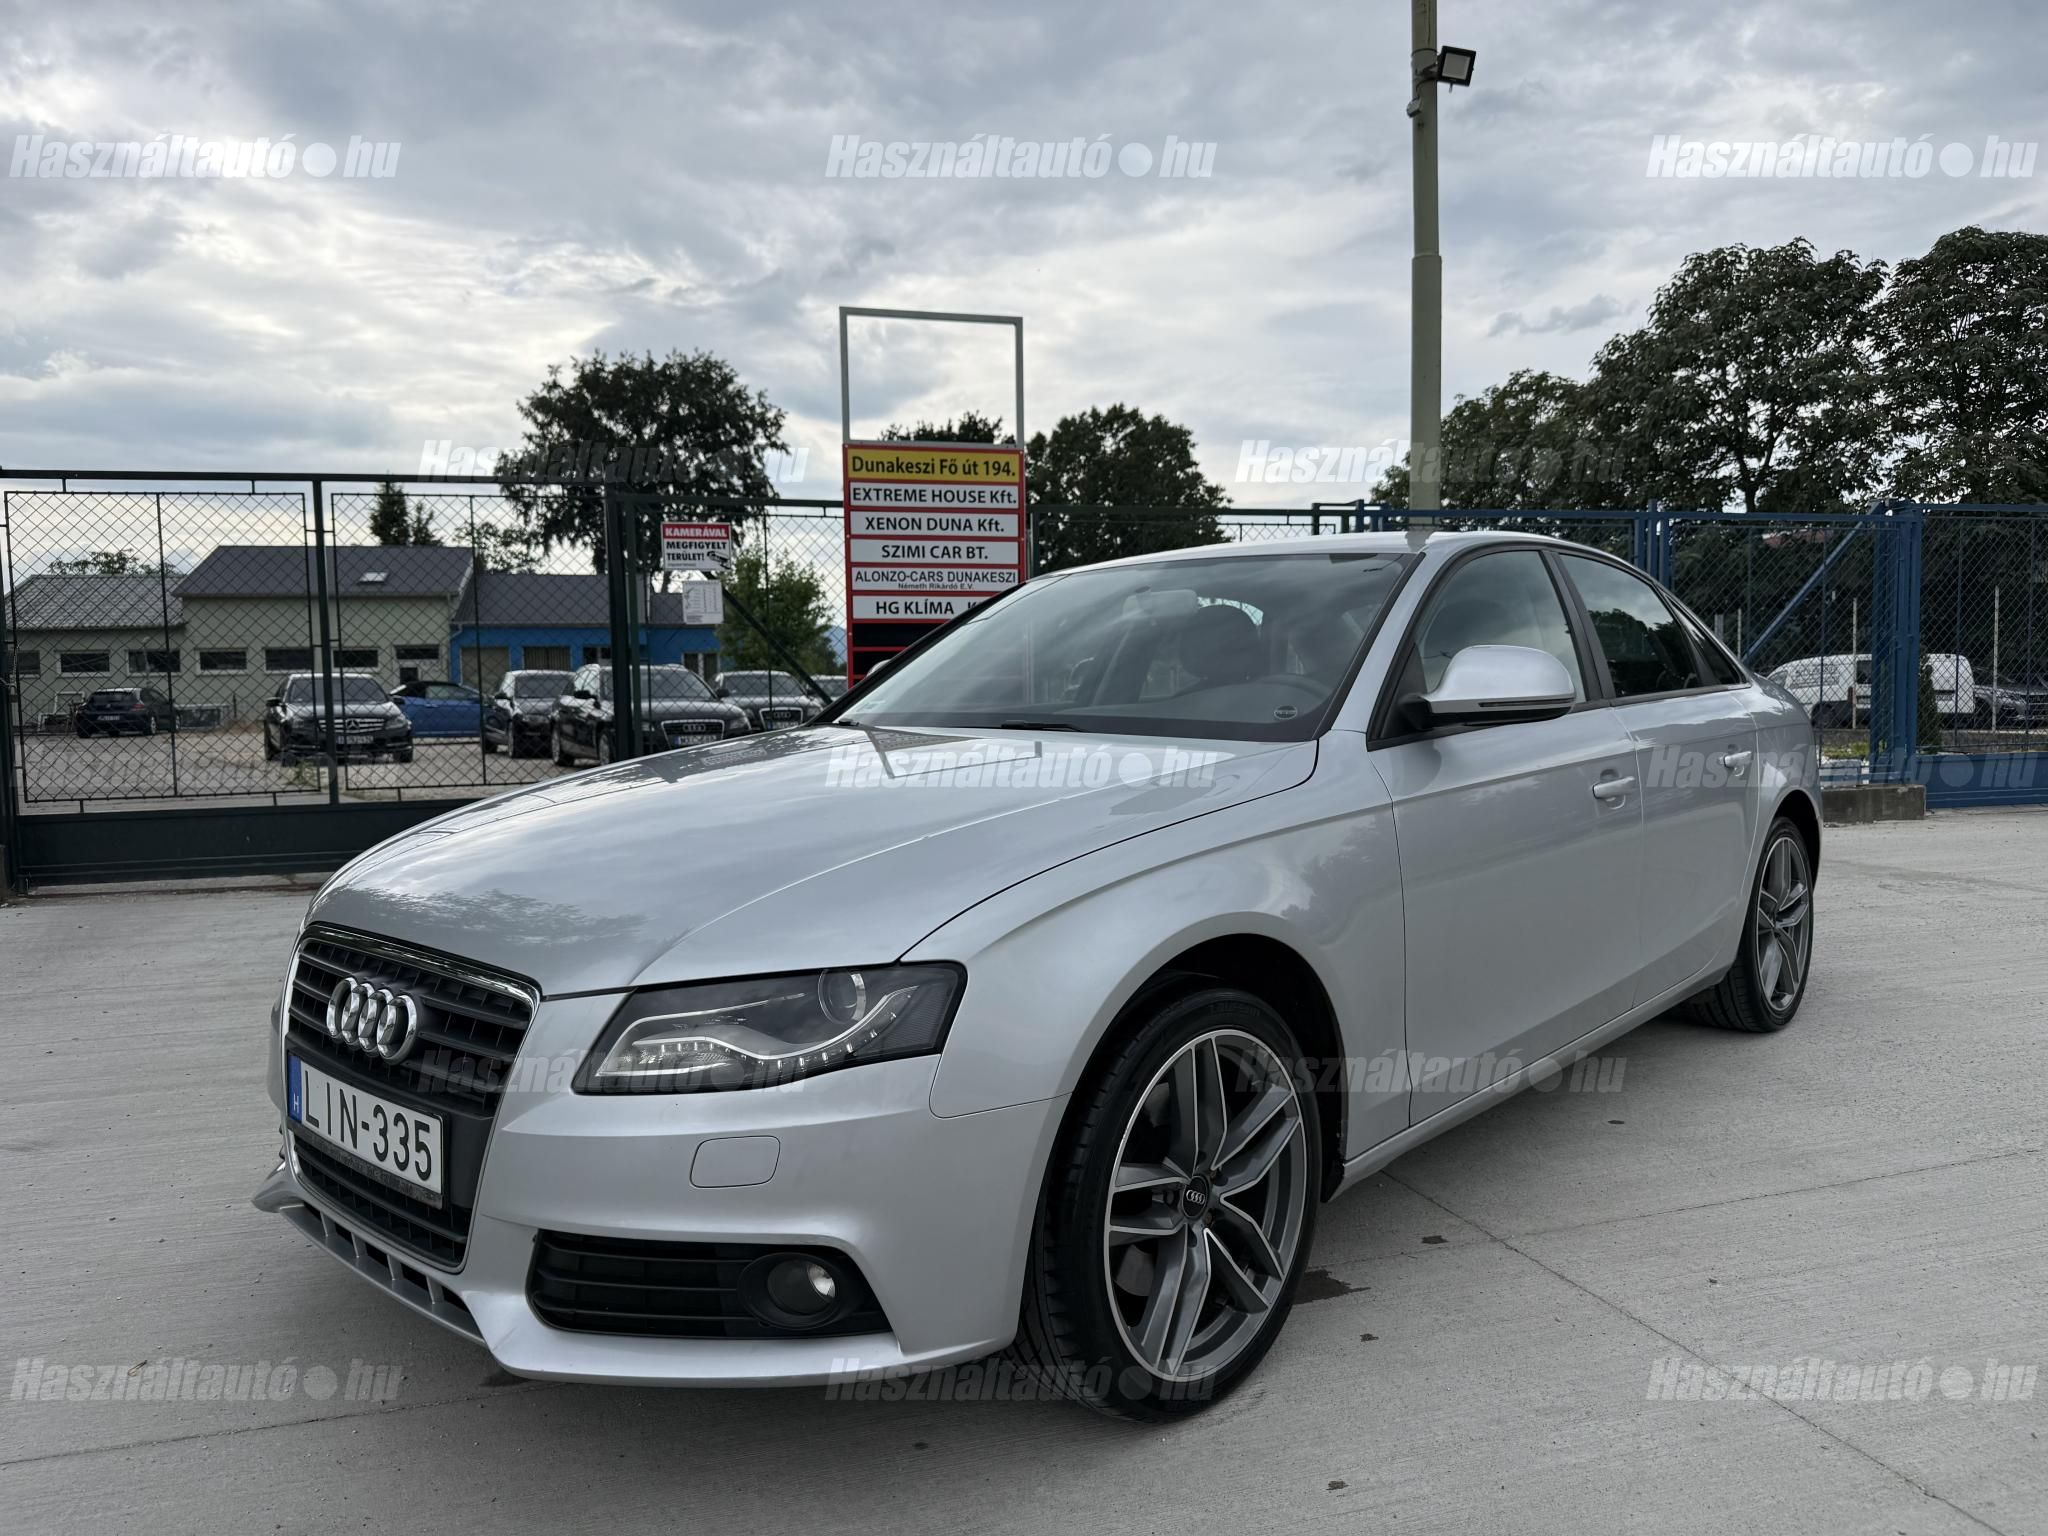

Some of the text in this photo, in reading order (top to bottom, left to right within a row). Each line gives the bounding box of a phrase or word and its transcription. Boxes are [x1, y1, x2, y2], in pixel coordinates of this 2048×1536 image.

[852, 456, 1016, 476] Dunakeszi Fő út 194.
[853, 487, 1017, 504] EXTREME HOUSE Kft.
[665, 526, 727, 537] KAMERÁVAL
[865, 516, 1005, 532] XENON DUNA Kft.
[666, 541, 727, 550] MEGFIGYELT
[881, 545, 989, 560] SZIMI CAR BT.
[855, 570, 1016, 583] ALONZO-CARS DUNAKESZI
[876, 601, 900, 615] HG
[904, 598, 954, 615] KLÍMA
[304, 1070, 433, 1181] LIN-335
